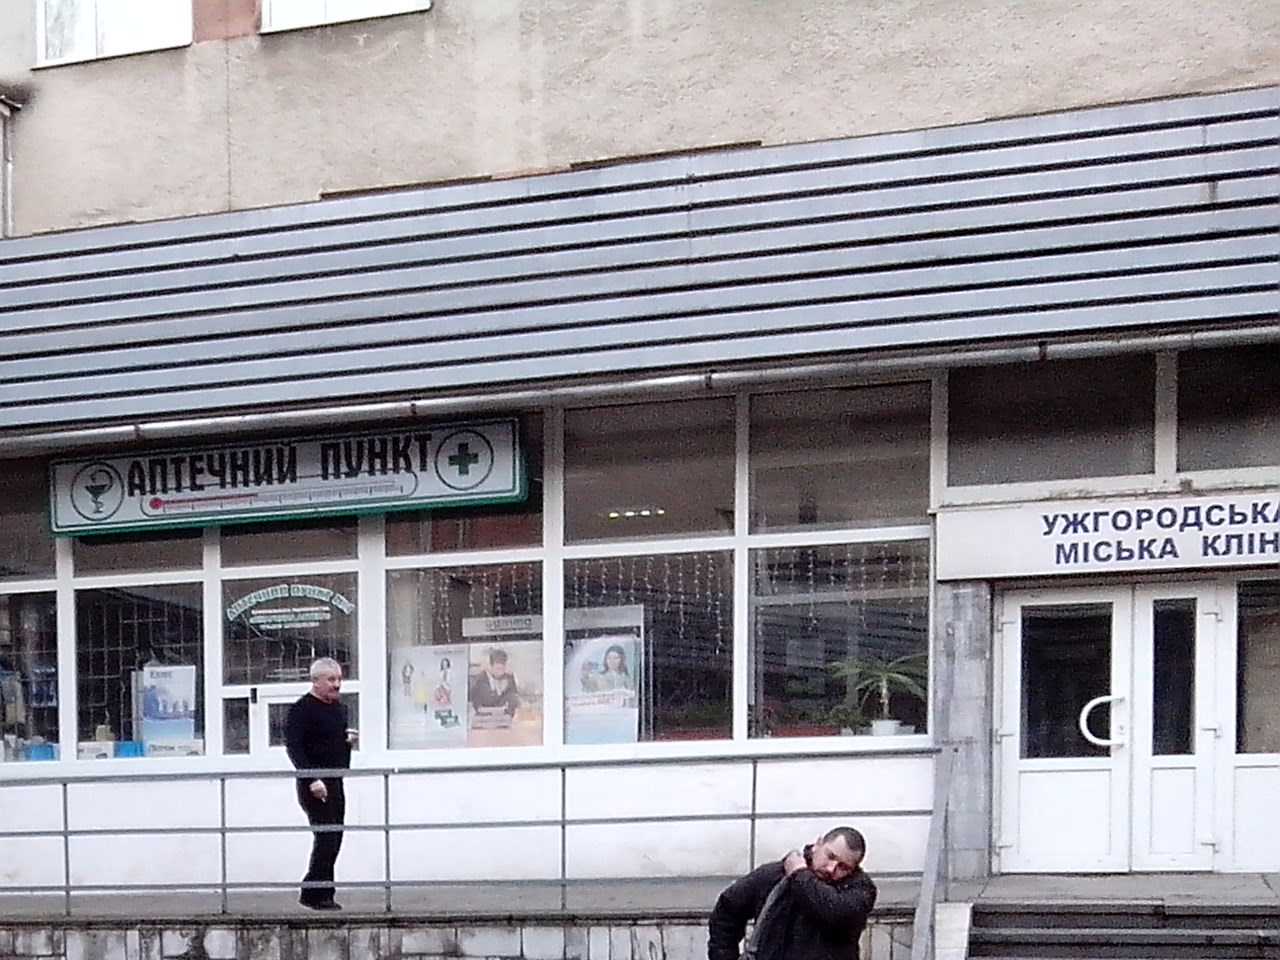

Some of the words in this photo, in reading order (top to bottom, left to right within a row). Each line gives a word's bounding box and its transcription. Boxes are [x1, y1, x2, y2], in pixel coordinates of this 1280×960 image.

[127, 444, 297, 497] АПТЕЧНИЙ
[321, 433, 433, 481] ПУНКТ
[1055, 537, 1179, 565] МІСЬКА
[1202, 532, 1280, 557] КЛІН
